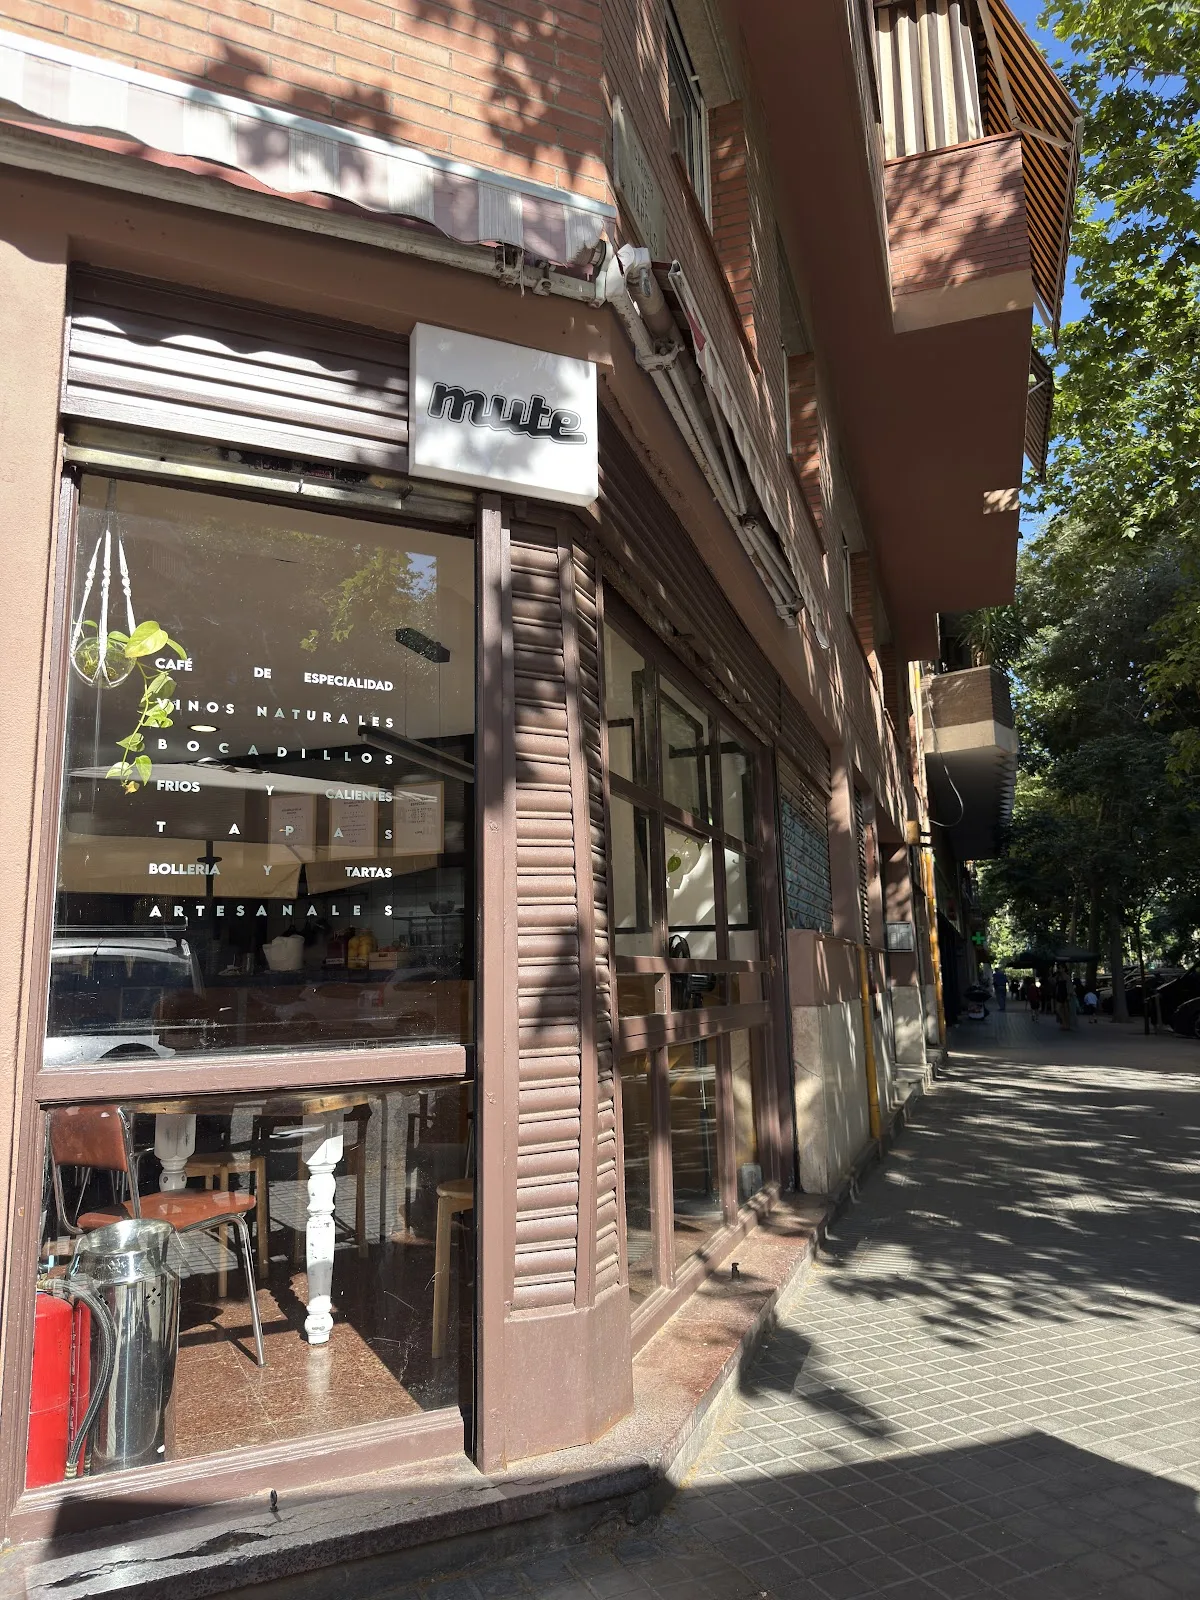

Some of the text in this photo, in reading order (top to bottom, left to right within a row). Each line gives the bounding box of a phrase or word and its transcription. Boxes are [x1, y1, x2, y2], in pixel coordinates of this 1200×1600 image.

[427, 382, 587, 444] mute
[155, 657, 394, 691] CAFÉ DE ESPECIALIDAD
[156, 698, 394, 728] VINOS NATURALES
[158, 739, 393, 765] BOCADILLOS
[157, 779, 201, 793] FRIOS
[265, 785, 275, 796] Y
[325, 788, 393, 802] CALIENTES
[149, 863, 393, 879] BOLLERIA Y TARTAS
[150, 905, 393, 918] ARTESANALES
